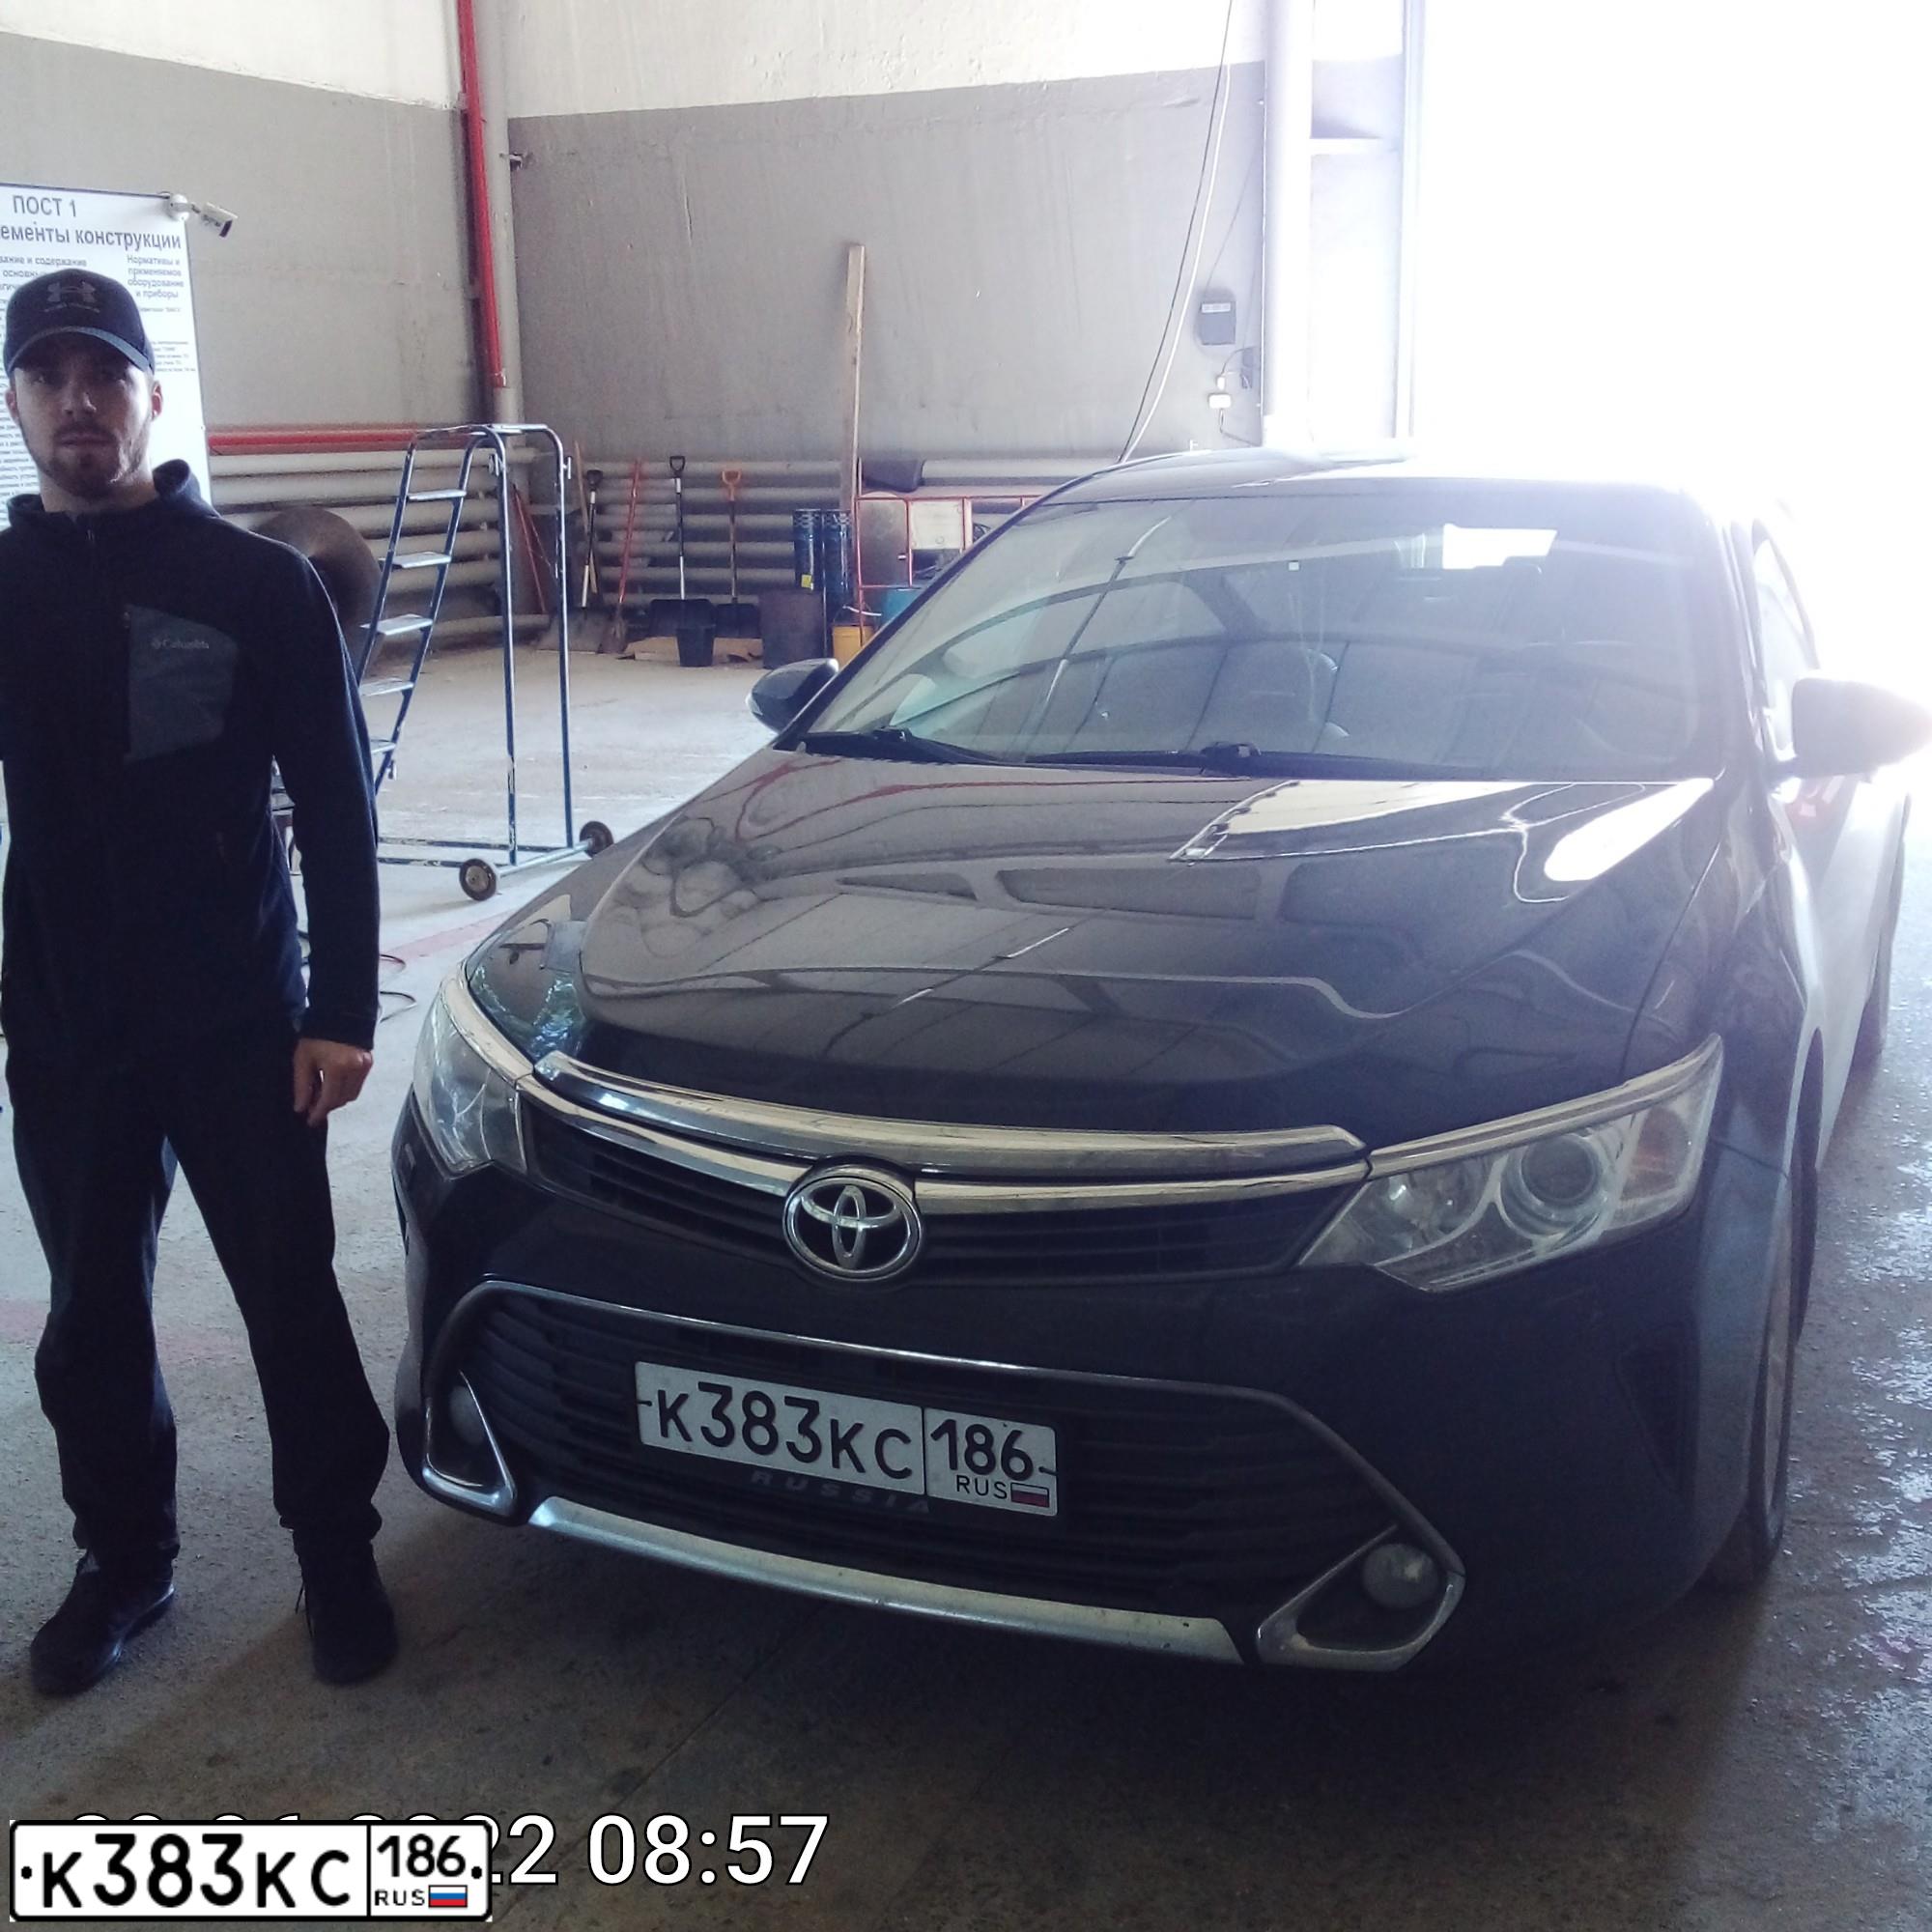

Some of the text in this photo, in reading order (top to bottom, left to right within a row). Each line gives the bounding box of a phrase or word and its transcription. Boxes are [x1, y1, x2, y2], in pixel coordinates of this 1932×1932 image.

[13, 195, 76, 217] ПОСТ 1
[0, 225, 182, 251] ементы конструкции
[35, 257, 87, 267] содержание
[127, 254, 173, 266] Нормативы
[128, 278, 185, 289] оборудование
[143, 291, 179, 300] приборы
[657, 1381, 1034, 1481] К383КС 186
[956, 1475, 1009, 1500] RUS
